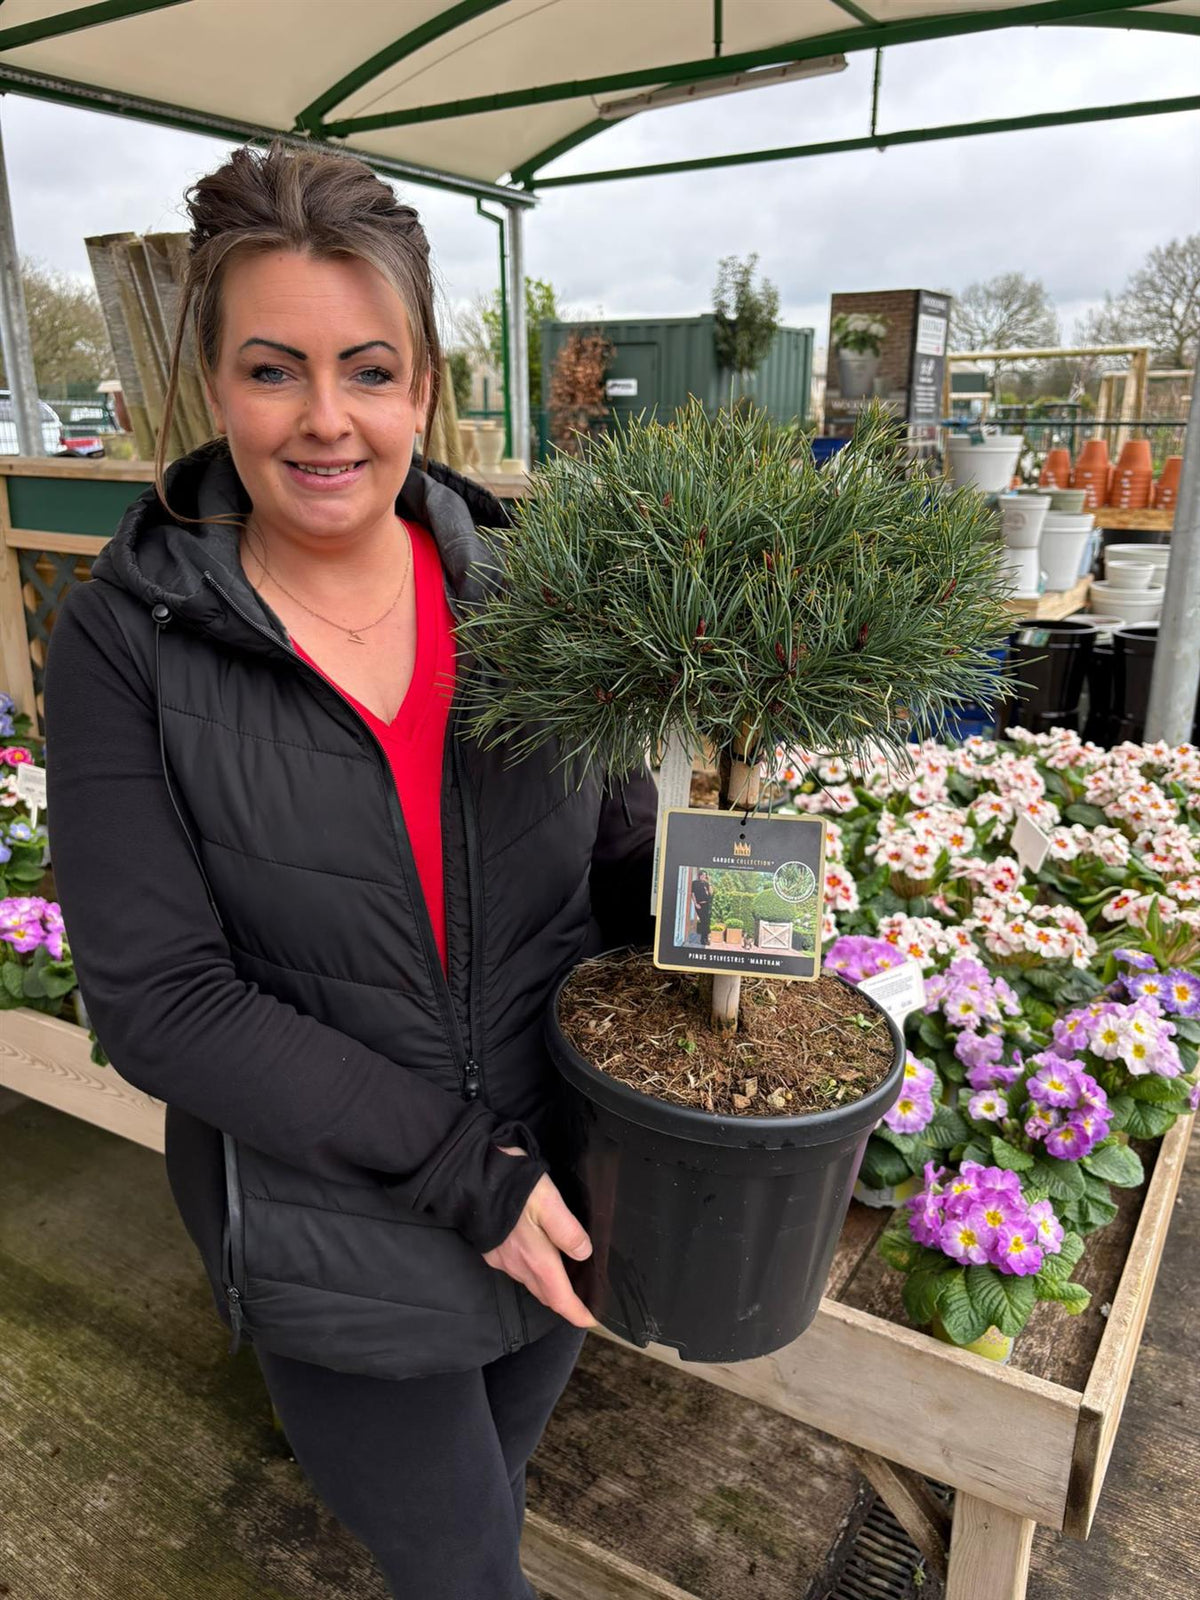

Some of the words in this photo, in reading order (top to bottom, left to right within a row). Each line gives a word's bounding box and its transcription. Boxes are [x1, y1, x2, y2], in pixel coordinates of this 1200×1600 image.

[712, 856, 735, 864] GARDEN
[688, 952, 707, 960] PINUS
[709, 954, 745, 964] SYLVESTRIS
